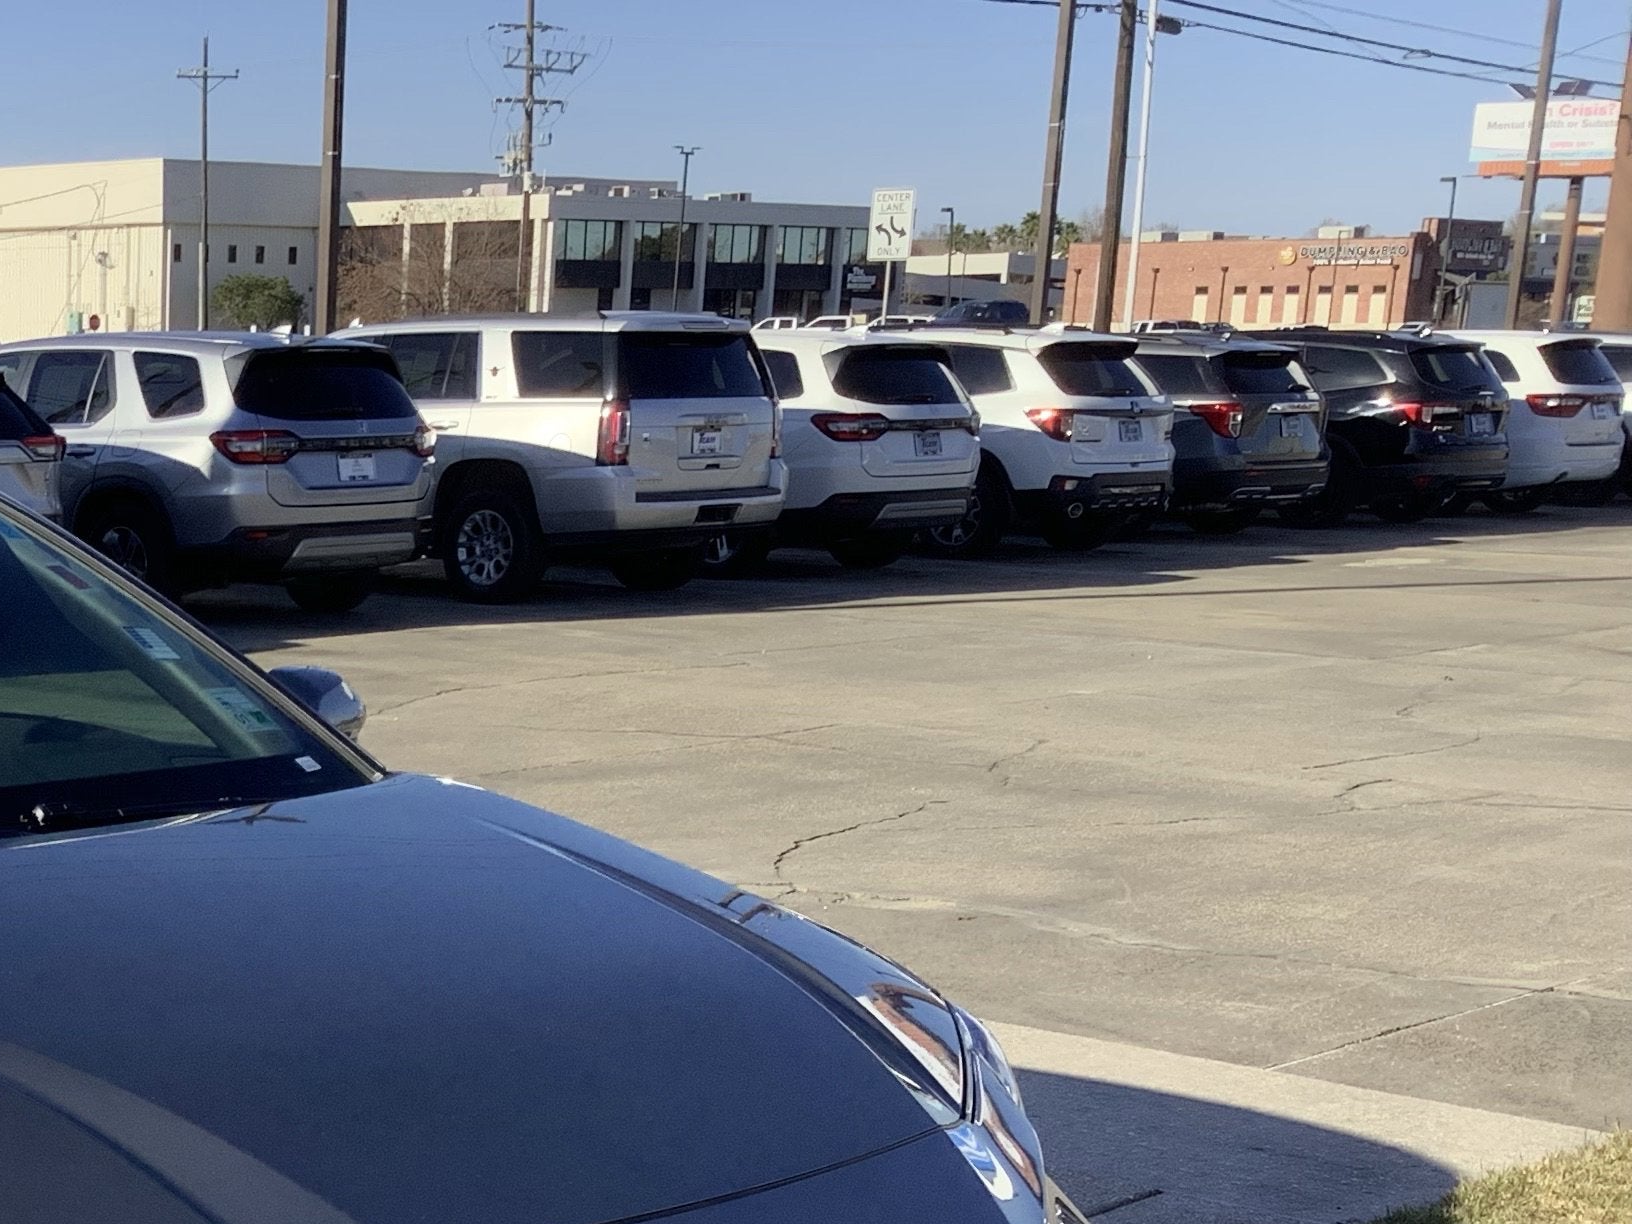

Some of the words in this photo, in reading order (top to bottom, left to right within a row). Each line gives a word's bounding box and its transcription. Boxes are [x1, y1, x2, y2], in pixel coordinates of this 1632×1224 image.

[1559, 103, 1618, 117] Crisis?
[1487, 120, 1526, 131] Mental
[1568, 121, 1580, 130] or
[877, 192, 911, 203] CENTER
[881, 202, 905, 212] LANE
[877, 247, 901, 256] ONLY
